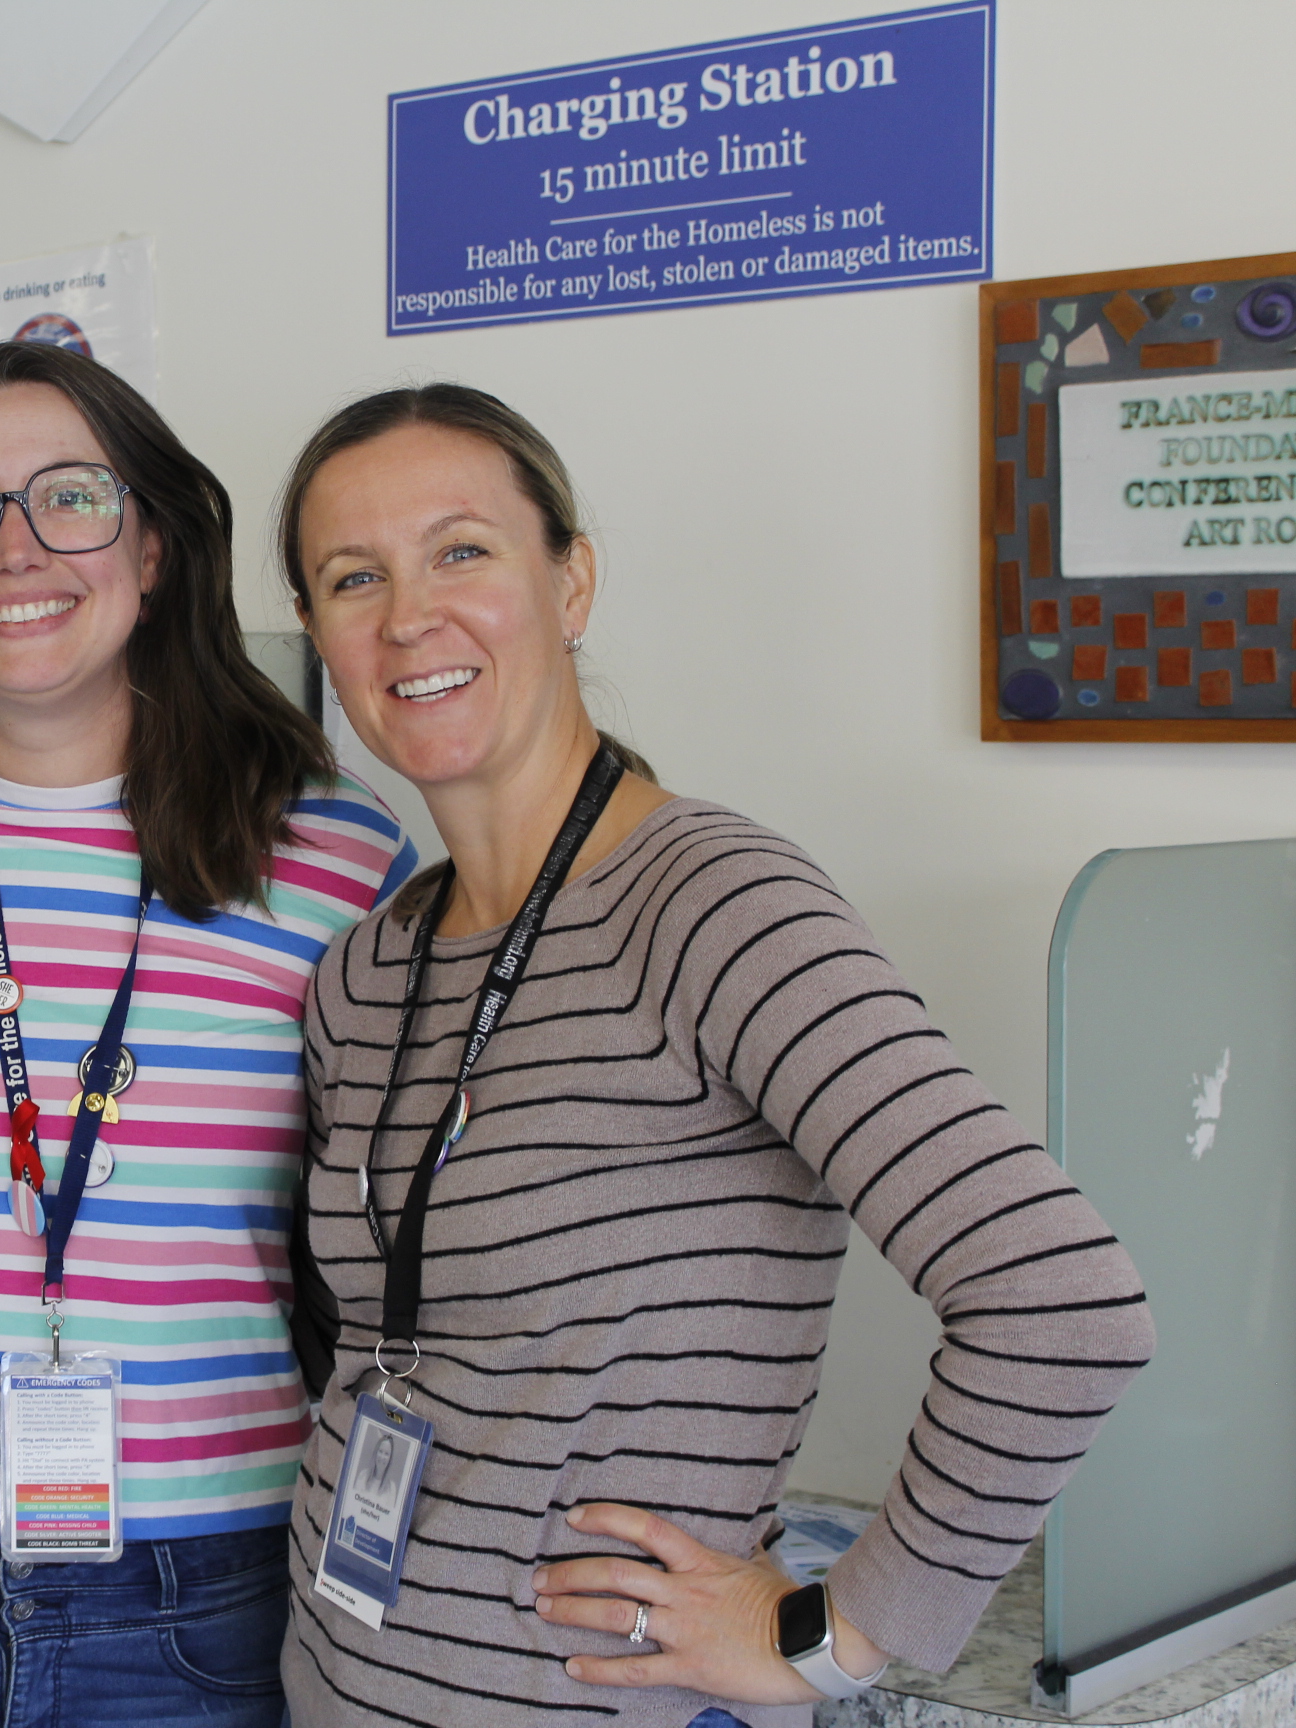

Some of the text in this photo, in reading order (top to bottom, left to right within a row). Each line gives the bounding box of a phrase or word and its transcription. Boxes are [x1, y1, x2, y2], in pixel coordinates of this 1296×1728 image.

[464, 46, 897, 145] Charging Station
[539, 128, 807, 203] 15 minute limit
[467, 202, 885, 271] Health Care for the Homeless is not
[3, 282, 50, 301] drinking
[53, 280, 66, 292] or
[69, 272, 106, 288] eating
[397, 234, 980, 315] responsible for any lost, stolen or damaged items.
[1160, 433, 1296, 467] FOUNDA
[1124, 473, 1296, 508] CONFEREN
[1184, 518, 1245, 547] ART
[0, 1016, 19, 1051] the
[6, 1056, 25, 1088] for
[31, 1379, 100, 1387] EMERGENCY CODES
[375, 1502, 390, 1515] Bauer
